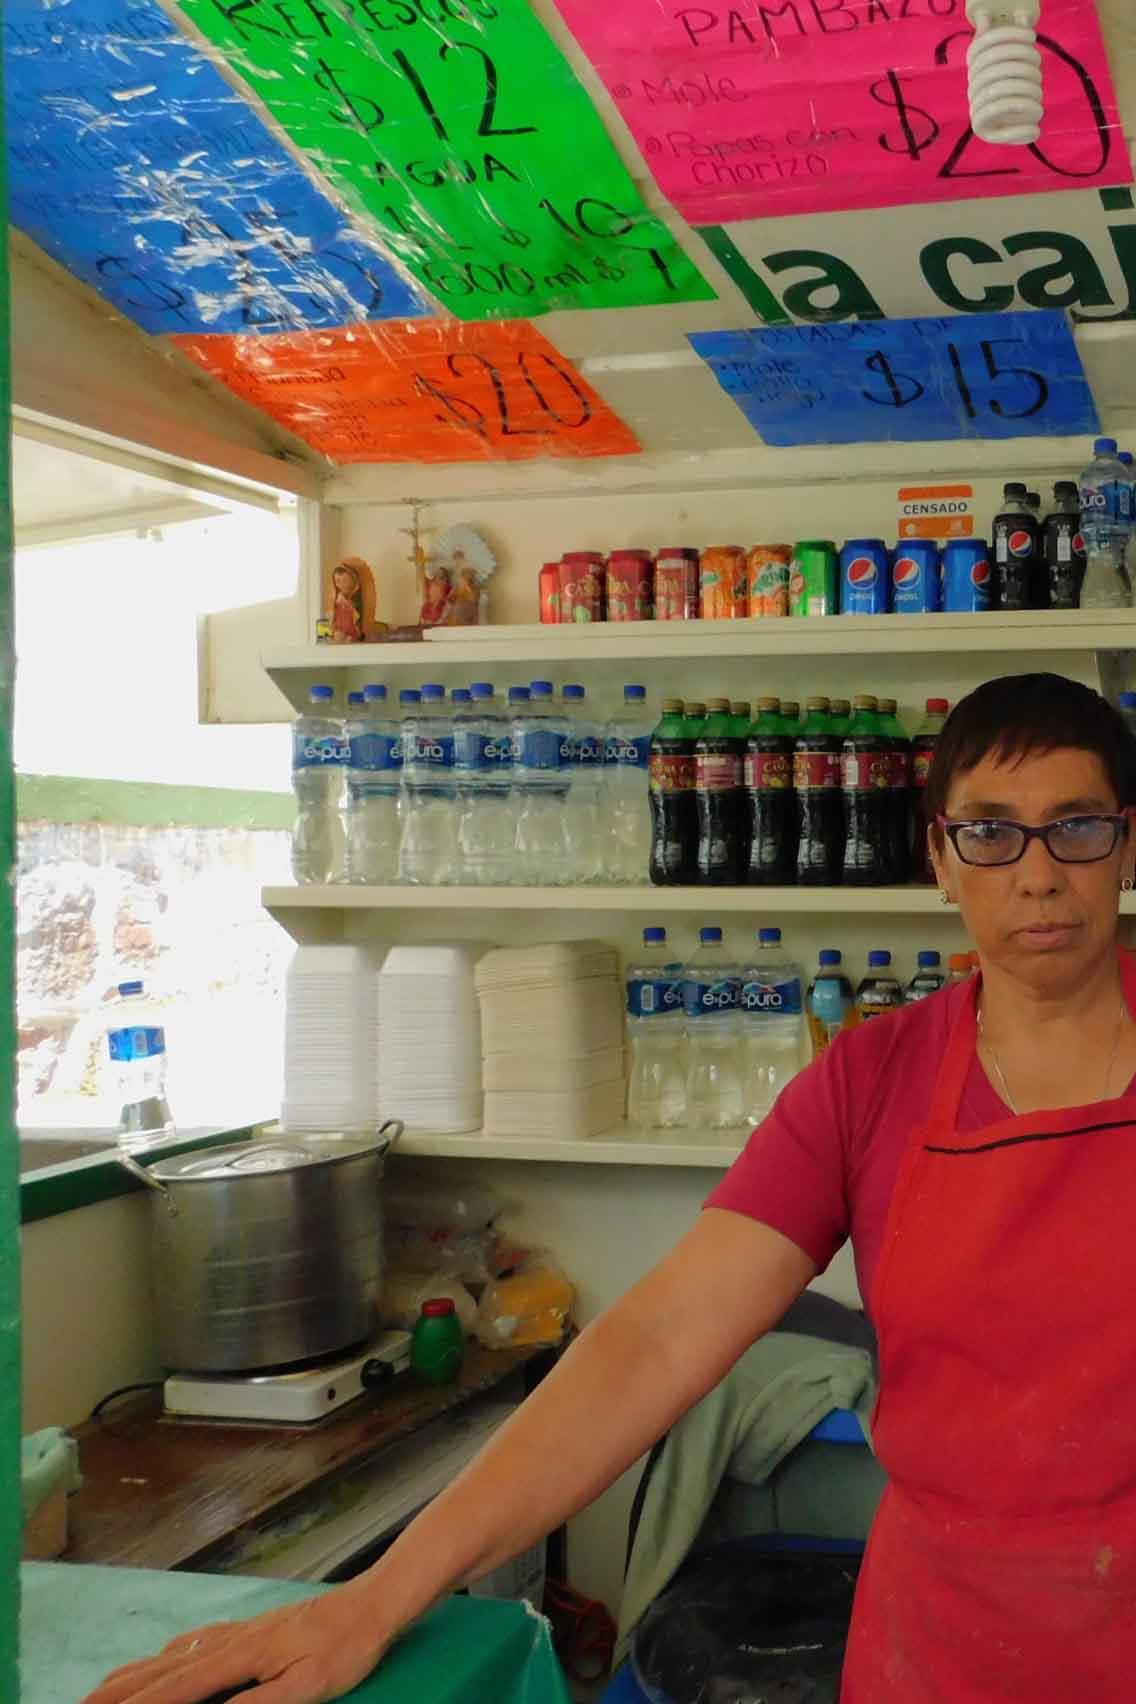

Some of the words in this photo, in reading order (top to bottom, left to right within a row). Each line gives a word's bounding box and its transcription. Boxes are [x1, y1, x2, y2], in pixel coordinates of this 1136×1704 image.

[691, 224, 884, 324] la
[862, 339, 1049, 419] $15
[903, 501, 968, 514] CENSADO
